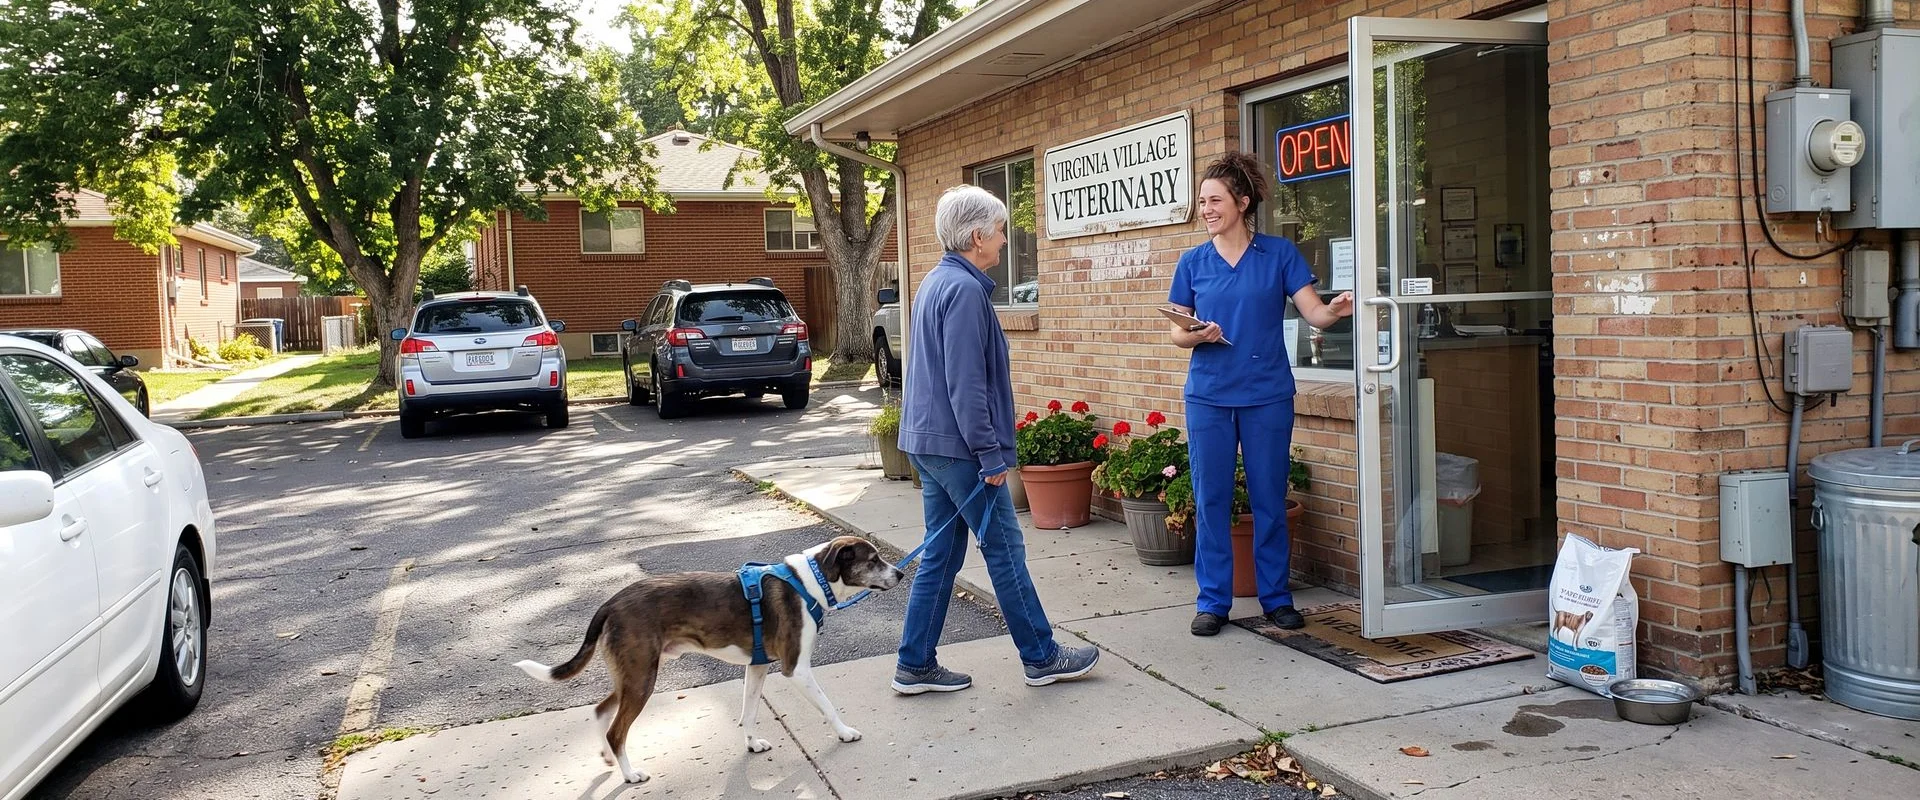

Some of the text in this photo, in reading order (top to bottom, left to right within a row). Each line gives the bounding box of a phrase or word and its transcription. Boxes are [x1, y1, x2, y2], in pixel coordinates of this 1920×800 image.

[1052, 133, 1178, 183] VIRGINIA VILLAGE
[1280, 121, 1349, 176] OPEN
[1051, 167, 1181, 222] VETERINARY
[1315, 616, 1437, 658] WELOME
